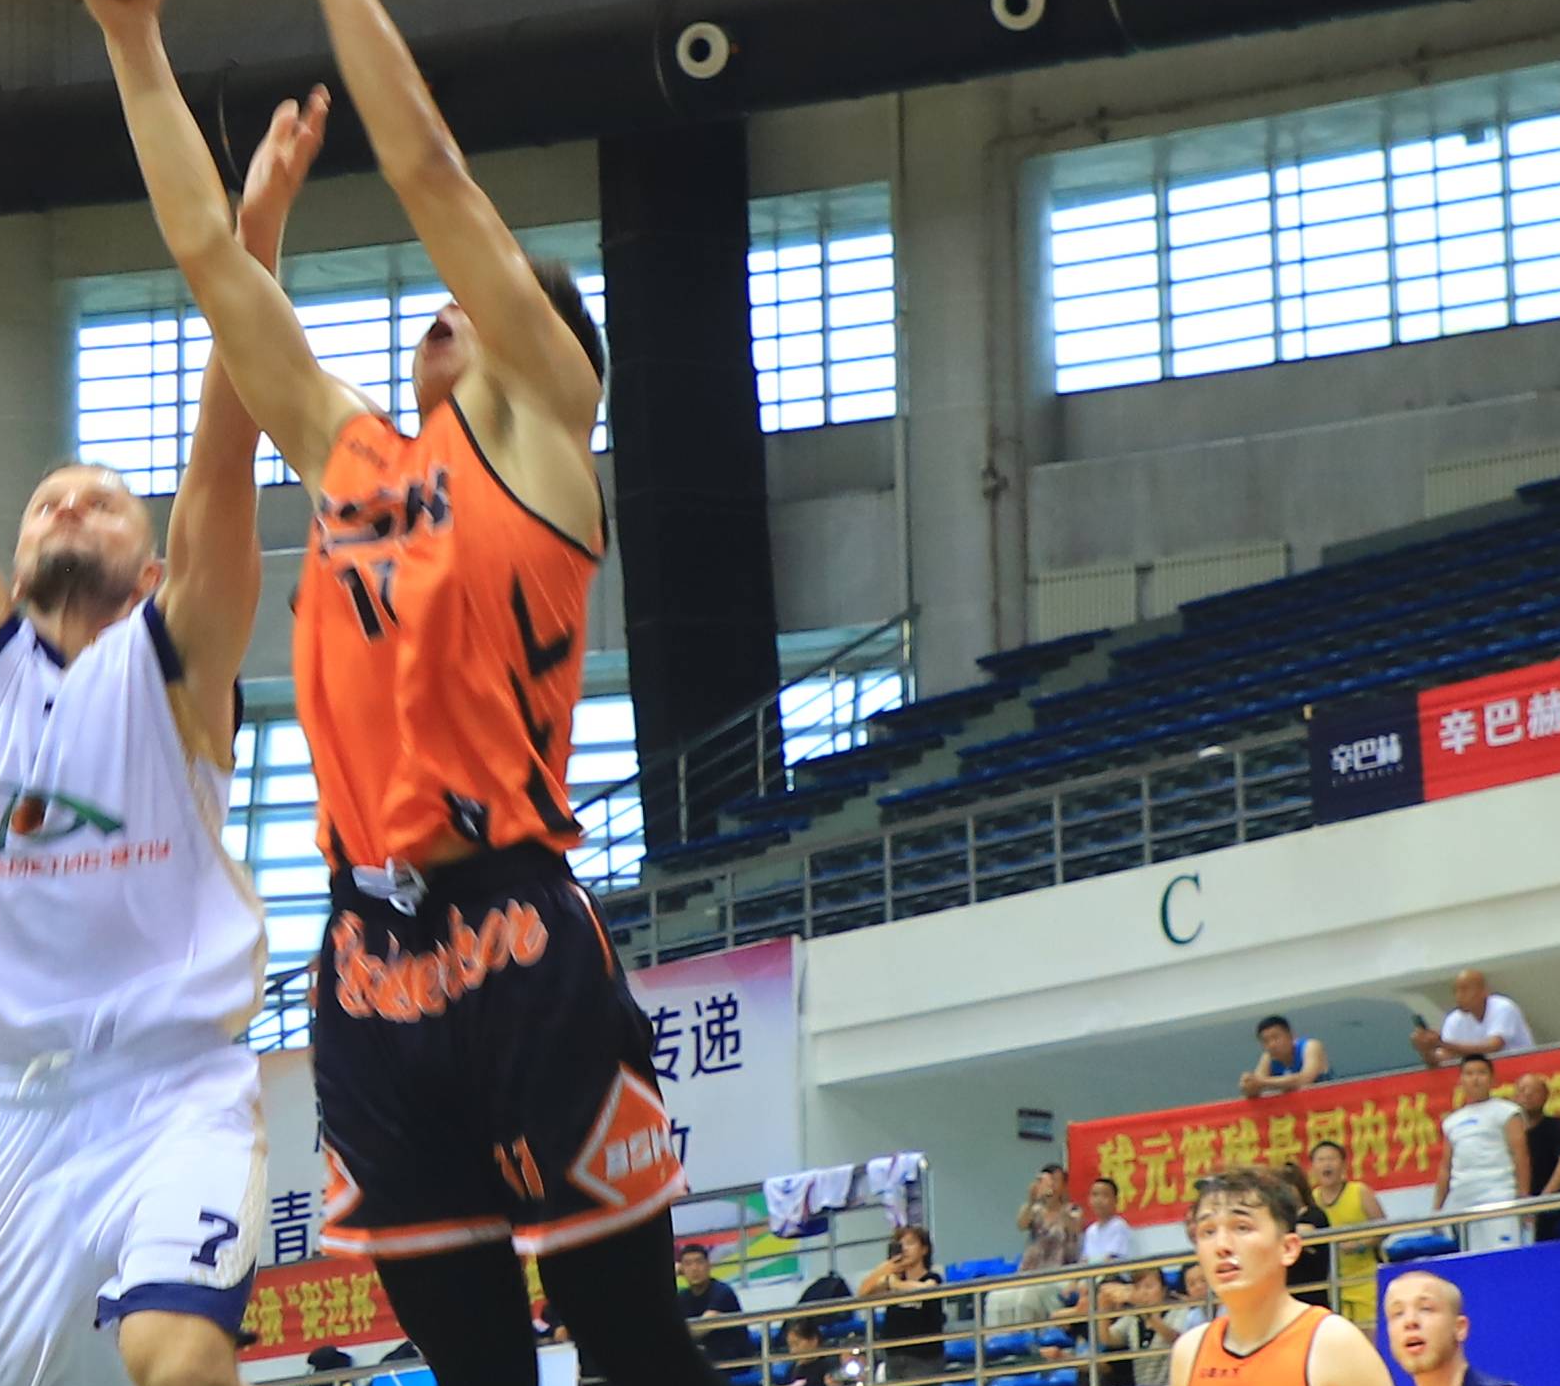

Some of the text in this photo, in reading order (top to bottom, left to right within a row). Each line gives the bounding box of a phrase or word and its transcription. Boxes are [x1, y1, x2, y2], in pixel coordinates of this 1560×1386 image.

[1329, 732, 1403, 776] 辛巴赫
[1158, 873, 1206, 947] C
[191, 1211, 240, 1270] 7
